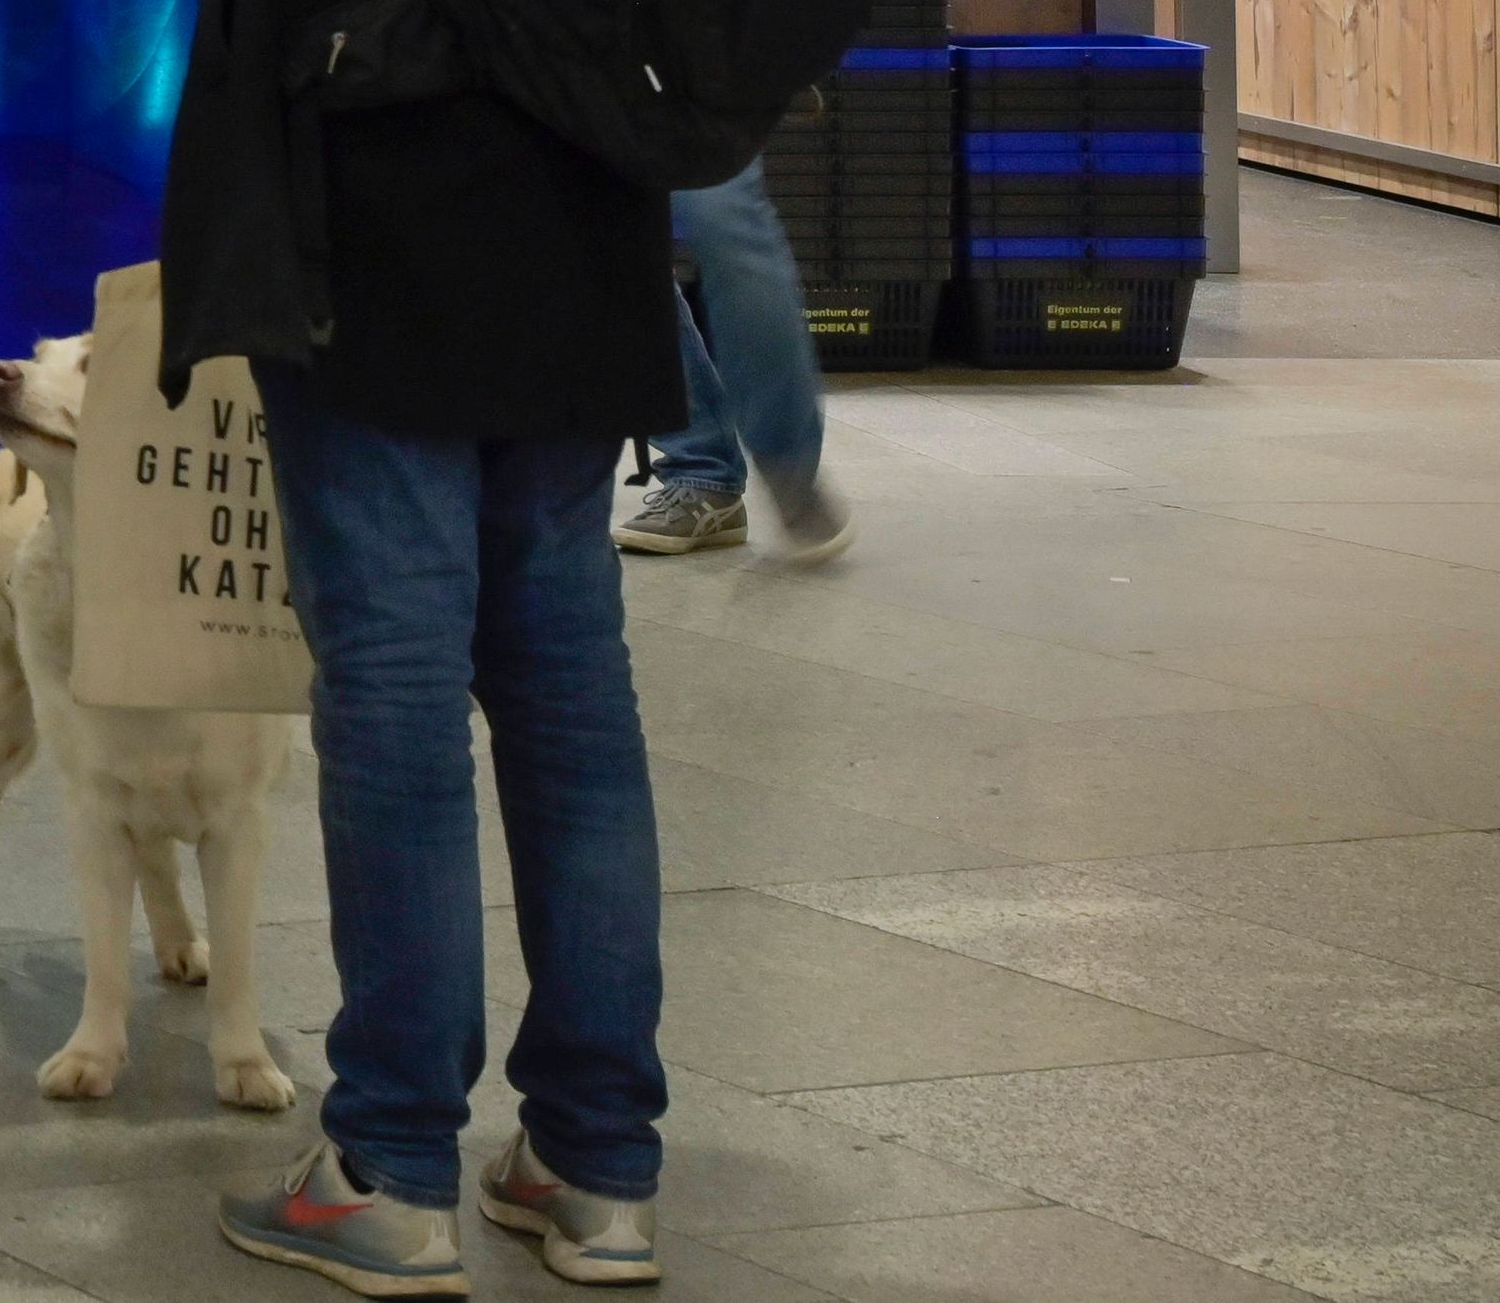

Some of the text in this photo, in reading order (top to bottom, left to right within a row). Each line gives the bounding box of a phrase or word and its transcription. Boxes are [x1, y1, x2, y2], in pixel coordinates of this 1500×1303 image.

[802, 307, 870, 319] igentum der
[1047, 304, 1123, 316] Eigentum der
[808, 323, 856, 333] EDEKA
[1061, 320, 1108, 330] EDEKA
[136, 444, 264, 498] GEHT
